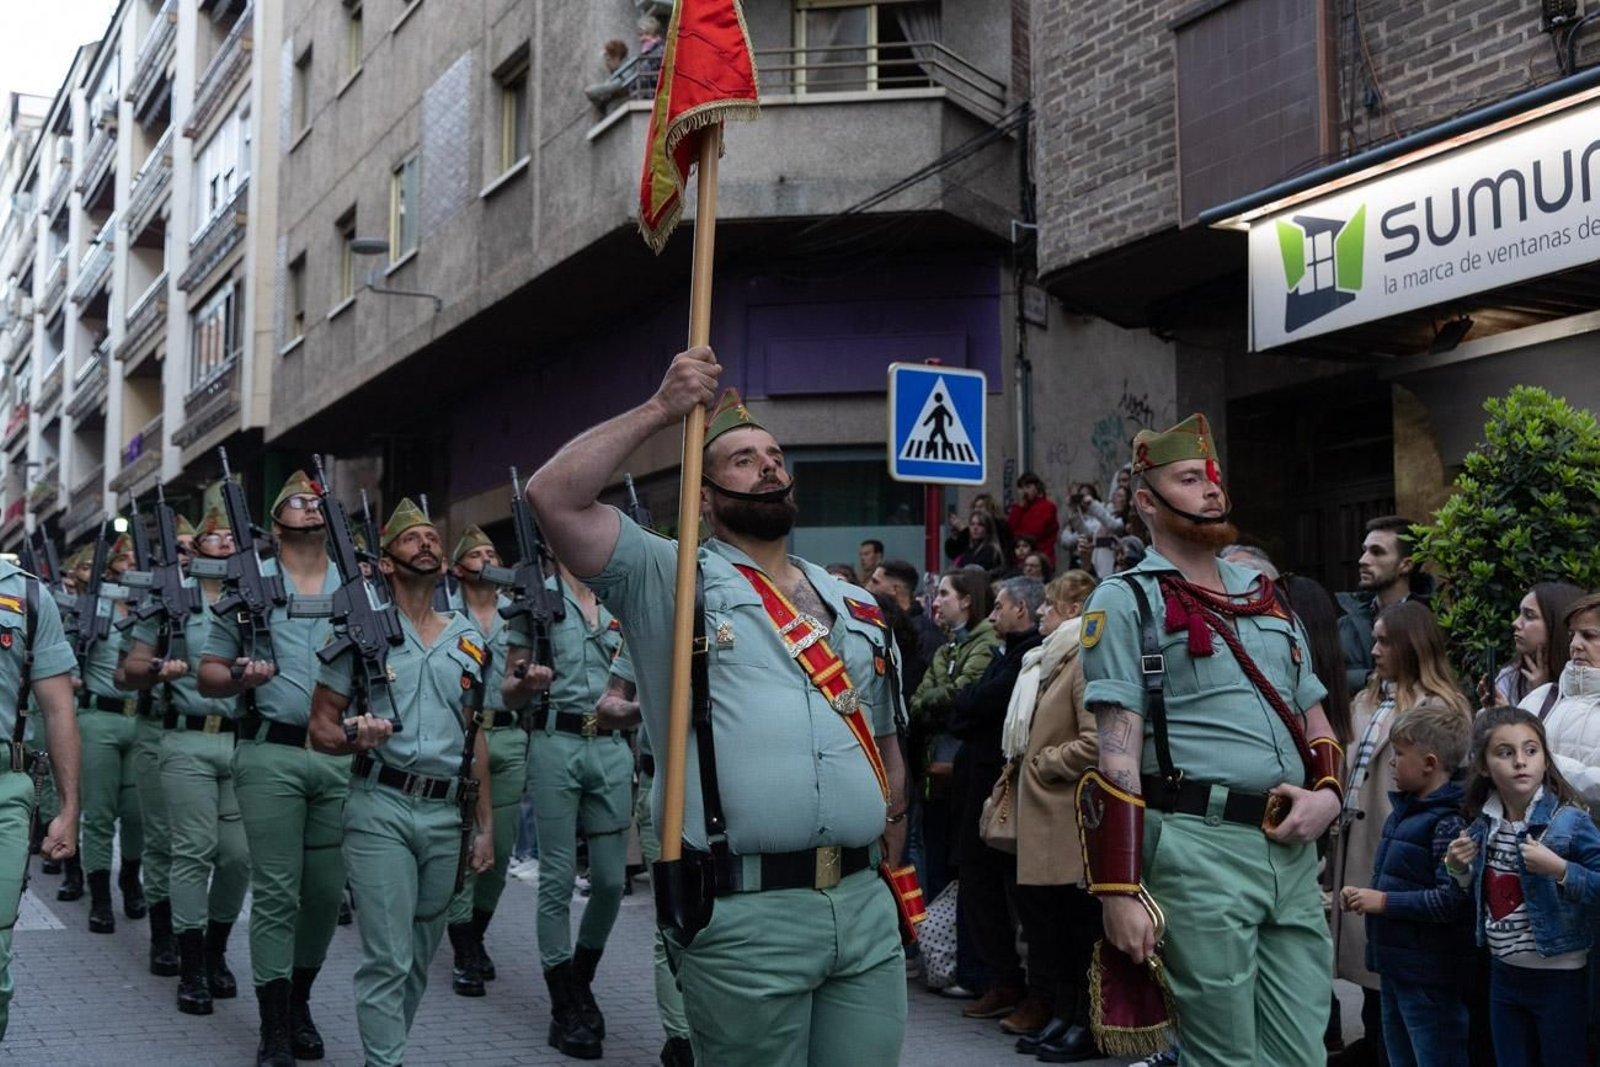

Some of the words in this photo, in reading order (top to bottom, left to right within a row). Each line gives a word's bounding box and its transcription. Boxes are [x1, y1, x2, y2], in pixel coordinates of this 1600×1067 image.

[1384, 275, 1398, 295] la
[1403, 262, 1454, 290] marca
[1460, 250, 1482, 274] de
[1487, 226, 1571, 265] ventanas
[1578, 215, 1600, 240] de
